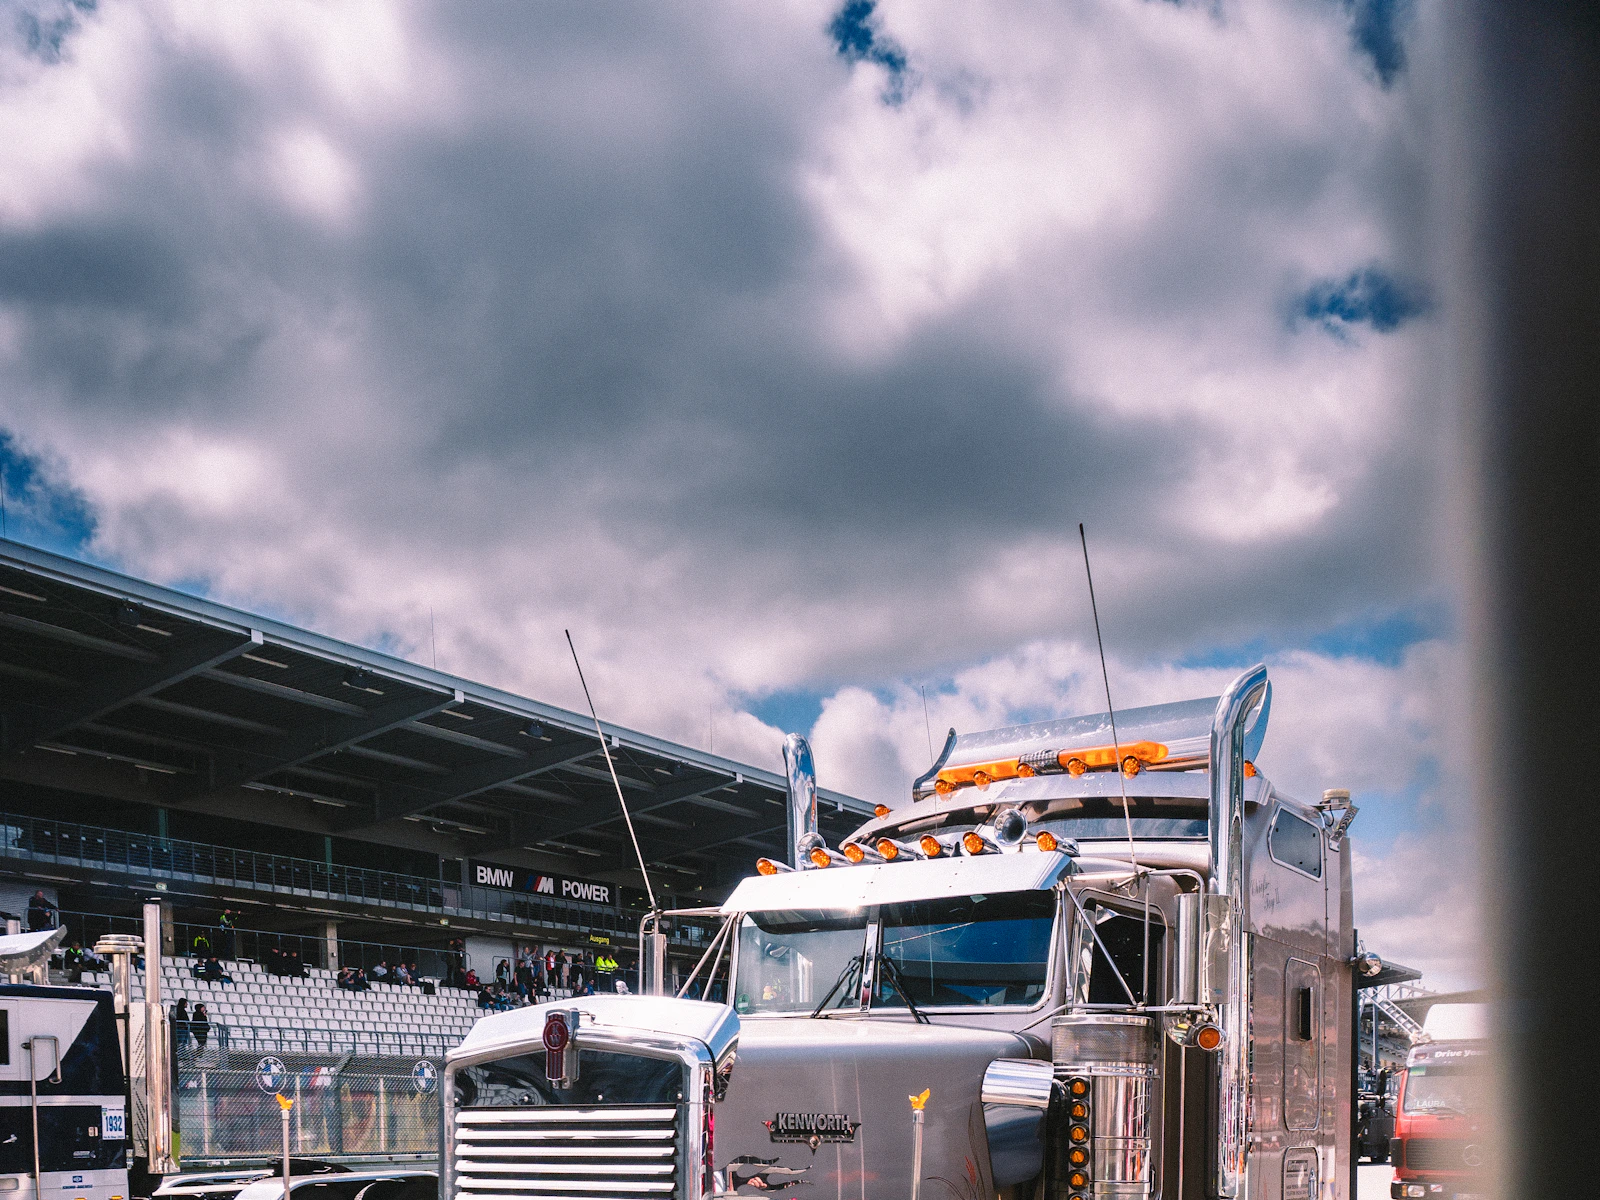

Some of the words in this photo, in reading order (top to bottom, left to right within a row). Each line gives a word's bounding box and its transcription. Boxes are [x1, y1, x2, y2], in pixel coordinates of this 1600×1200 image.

[476, 865, 514, 888] BMW
[561, 879, 610, 903] POWER
[590, 934, 610, 946] Ausgang
[1416, 1099, 1446, 1108] LAURA
[105, 1115, 123, 1132] 1932
[778, 1113, 850, 1131] KENWORTH
